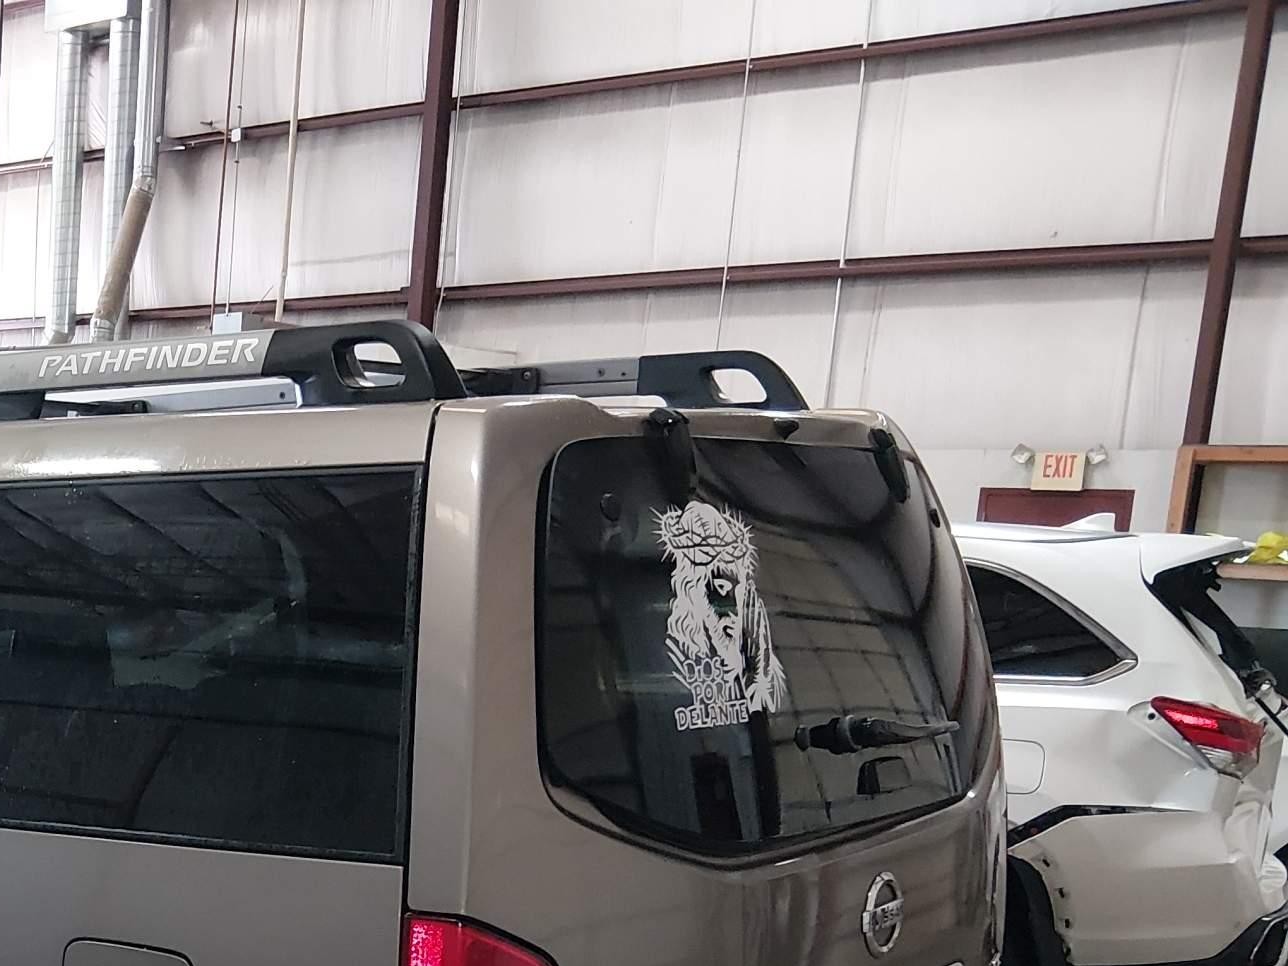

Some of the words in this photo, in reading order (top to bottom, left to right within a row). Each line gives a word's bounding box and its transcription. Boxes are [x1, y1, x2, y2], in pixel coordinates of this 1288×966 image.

[38, 337, 259, 378] PATHFINDER
[1042, 454, 1078, 479] EXIT
[691, 680, 726, 705] POR
[674, 699, 749, 731] DELANTE
